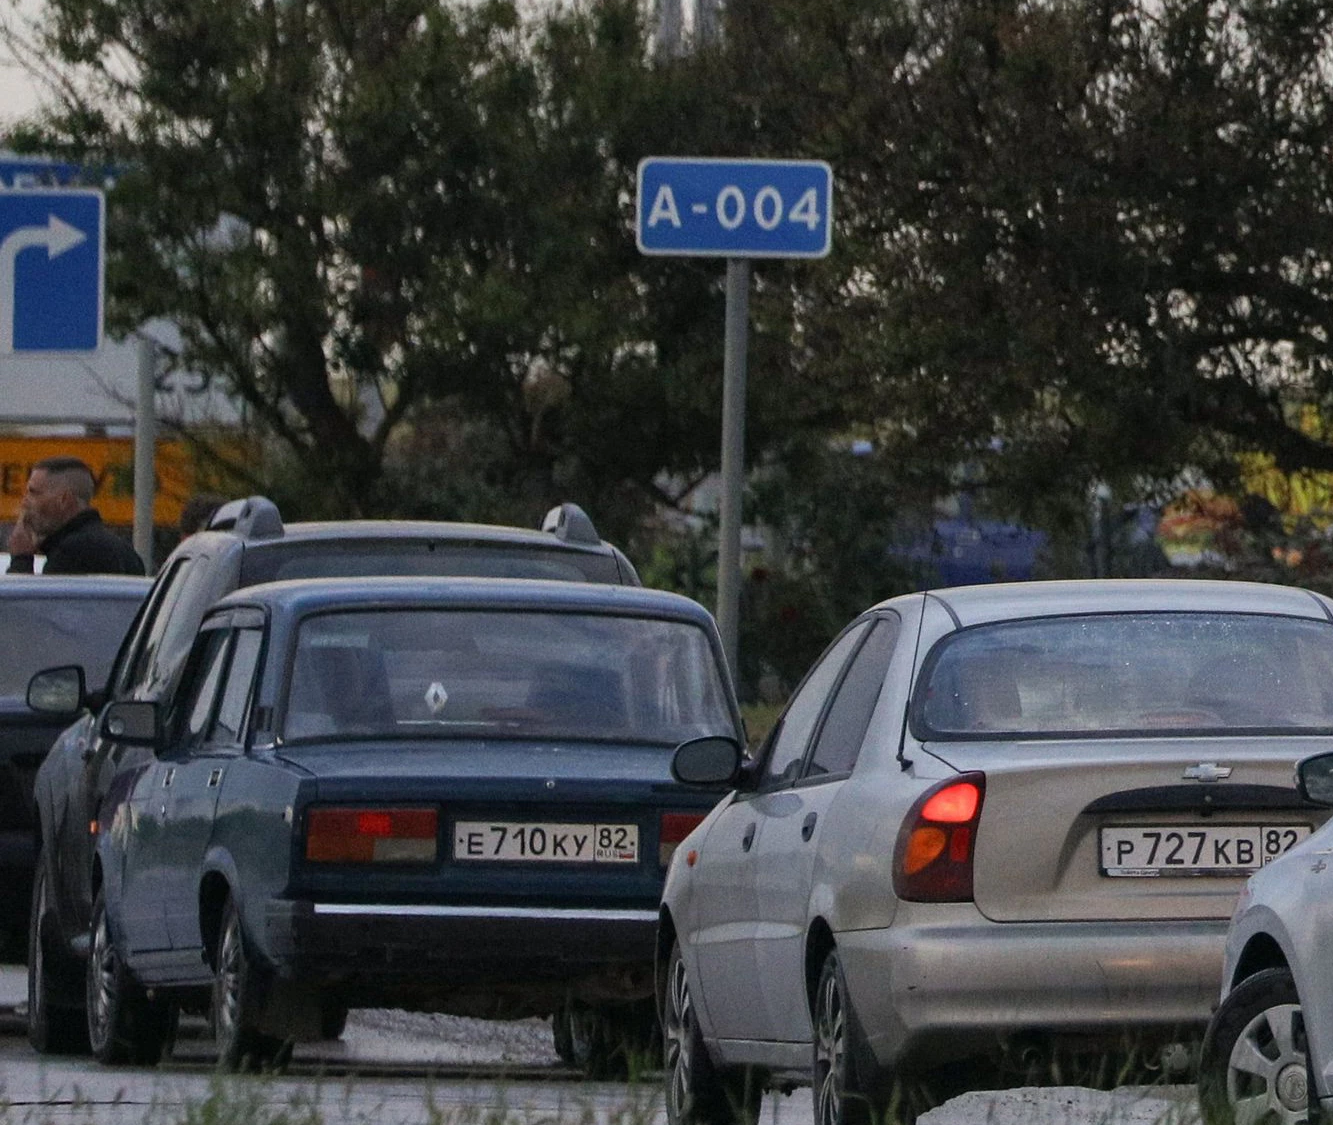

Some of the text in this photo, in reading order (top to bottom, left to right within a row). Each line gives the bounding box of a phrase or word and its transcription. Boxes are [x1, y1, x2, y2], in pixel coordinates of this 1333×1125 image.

[647, 183, 821, 231] А-004
[597, 827, 629, 850] 82
[597, 849, 619, 859] RUS
